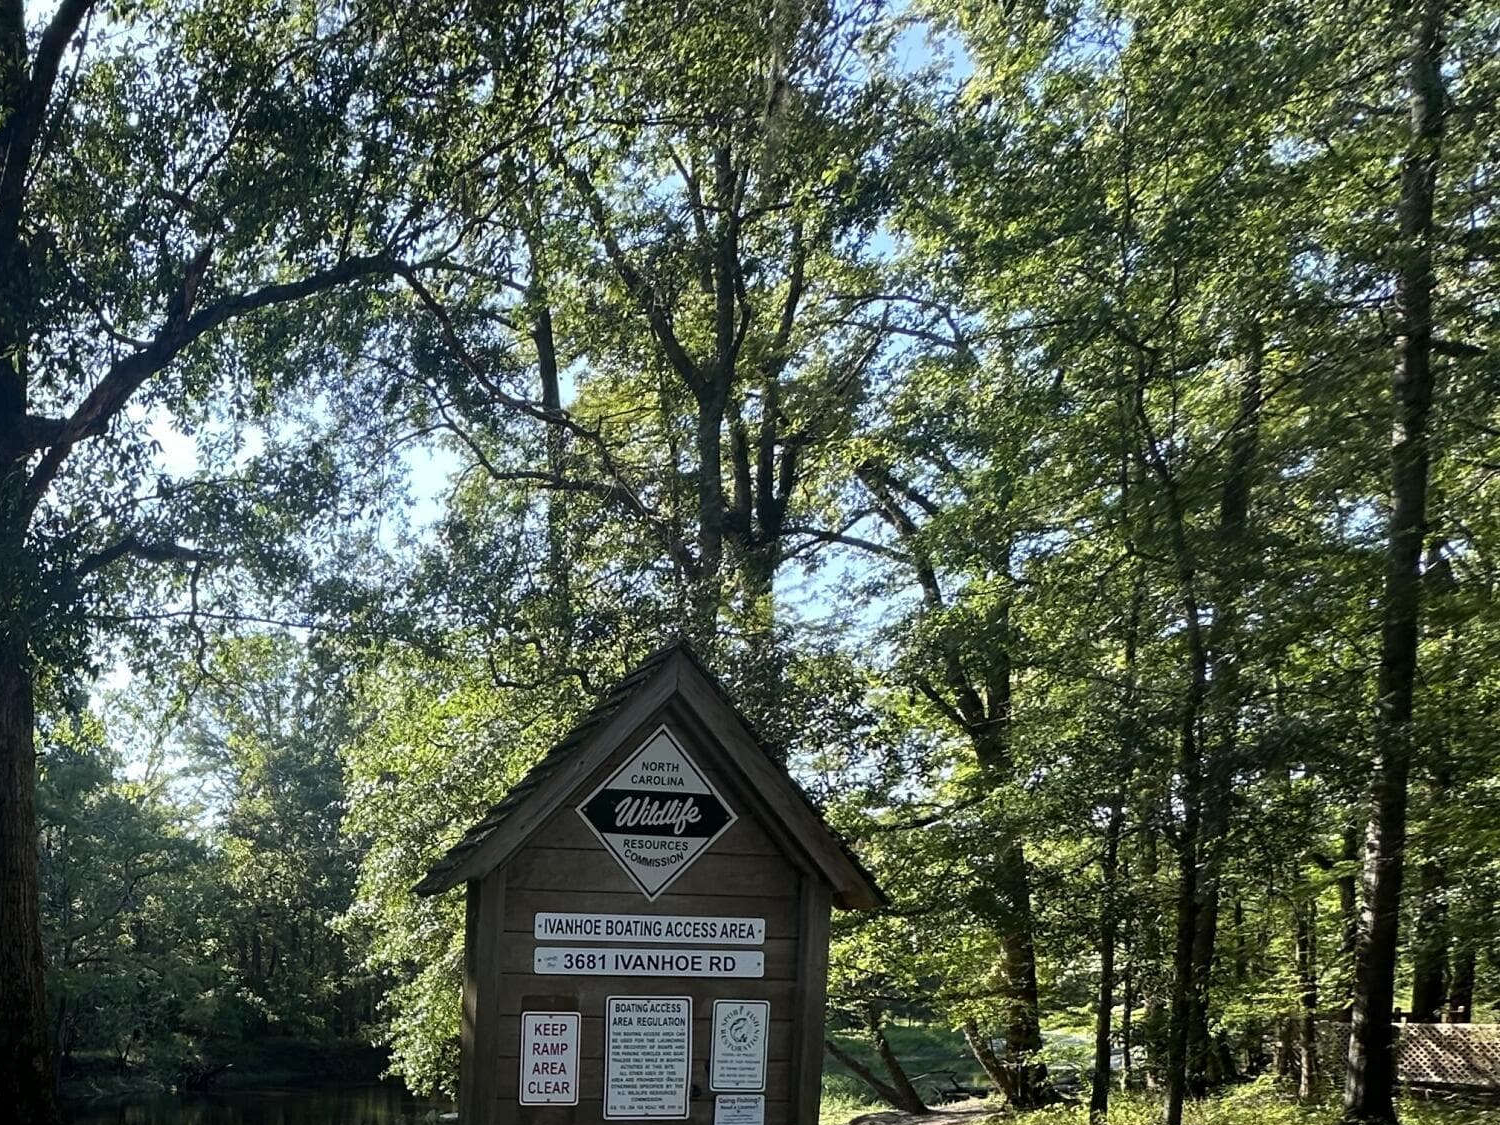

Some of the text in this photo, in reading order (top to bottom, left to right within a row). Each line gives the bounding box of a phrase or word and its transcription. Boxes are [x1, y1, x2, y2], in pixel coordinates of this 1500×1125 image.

[642, 762, 679, 772] NORTH
[631, 775, 684, 786] CAROLINA
[615, 796, 702, 835] Wildlife
[623, 839, 689, 851] RESOURCES
[625, 850, 684, 867] COMMISSION
[544, 918, 755, 938] IVANHOE BOATING ACCESS AREA
[564, 954, 736, 972] 3681 IVANHOE RD
[615, 1004, 681, 1013] BOATING ACCESS
[612, 1017, 685, 1026] AREA REGULATION
[535, 1024, 567, 1036] KEEP
[532, 1043, 568, 1055] RAMP
[532, 1062, 566, 1075] AREA
[528, 1082, 570, 1094] CLEAR
